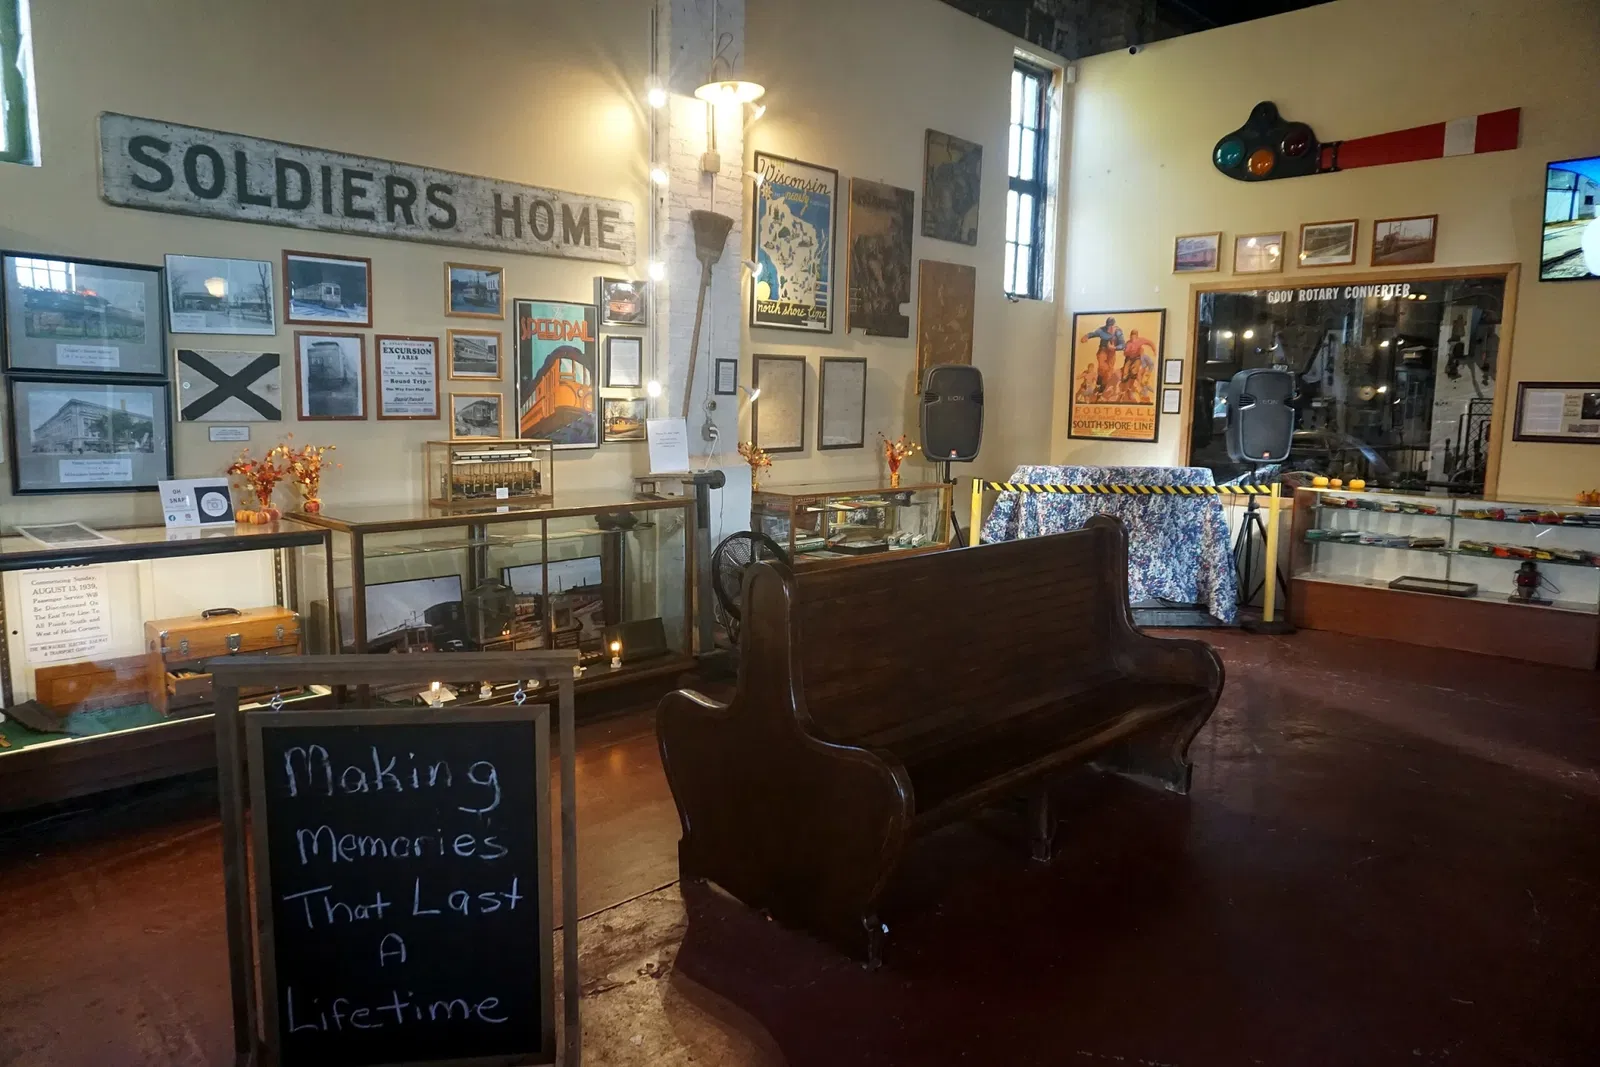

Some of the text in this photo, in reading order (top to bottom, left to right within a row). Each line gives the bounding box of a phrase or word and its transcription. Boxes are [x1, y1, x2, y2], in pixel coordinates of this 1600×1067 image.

[128, 134, 622, 251] SOLDIERS HOME
[759, 158, 832, 195] Wisconsin
[757, 300, 827, 319] north shore line
[1267, 283, 1411, 304] 600V ROTARY CONVERTER
[383, 347, 432, 355] EXCURSION
[1075, 407, 1154, 417] FOOTBALL
[32, 586, 67, 595] AUGUST
[80, 583, 98, 591] 1939,
[284, 744, 503, 814] Making
[283, 876, 524, 930] That Last
[379, 932, 407, 967] A
[287, 986, 510, 1033] Lifetime
